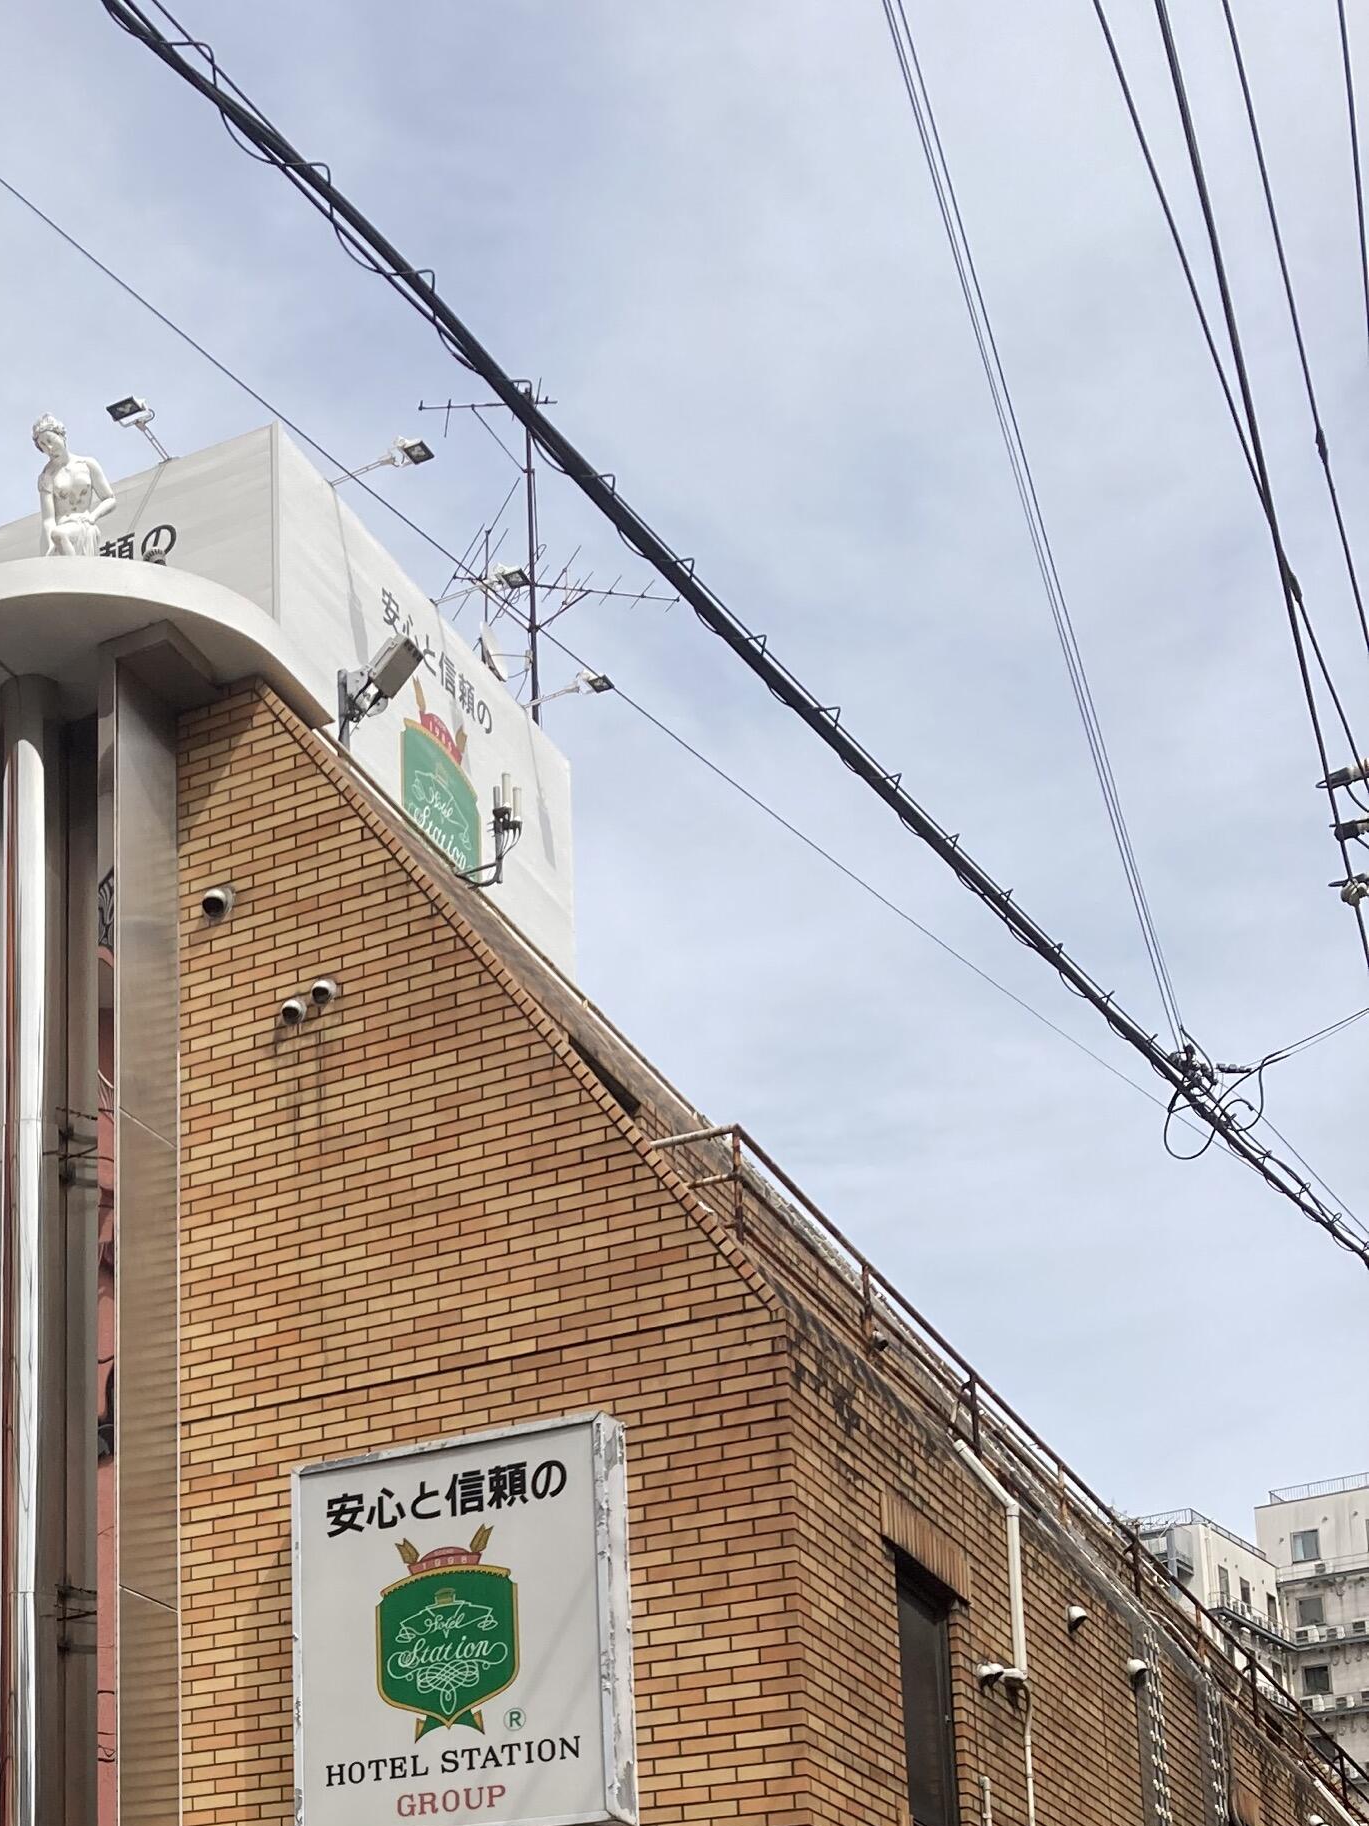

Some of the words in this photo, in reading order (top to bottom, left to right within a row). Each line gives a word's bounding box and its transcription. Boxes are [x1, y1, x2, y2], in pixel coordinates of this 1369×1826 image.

[326, 1459, 567, 1538] 安心と信頼の
[398, 1635, 491, 1668] Station
[325, 1753, 429, 1788] HOTEL
[440, 1735, 581, 1776] STATION
[396, 1784, 506, 1818] GROUP
